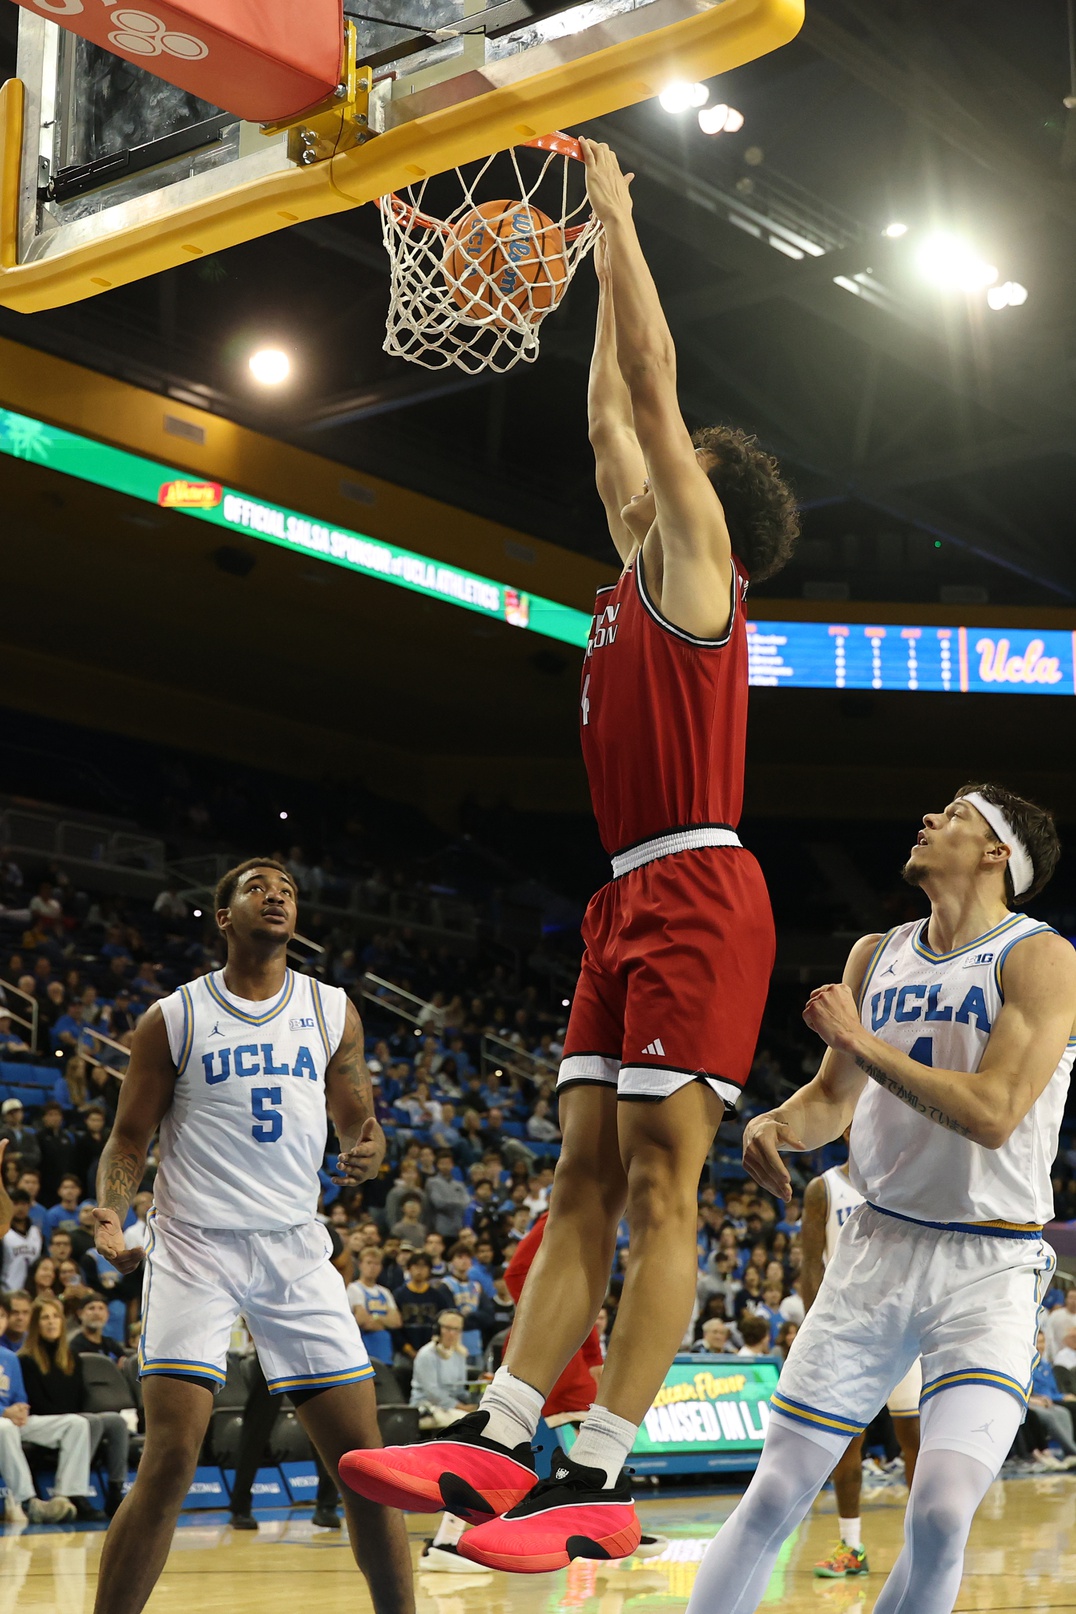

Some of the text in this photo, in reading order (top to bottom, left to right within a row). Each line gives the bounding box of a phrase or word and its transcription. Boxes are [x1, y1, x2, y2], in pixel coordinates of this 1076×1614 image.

[223, 494, 286, 539] OFFICIAL
[287, 516, 331, 554] SALSA
[330, 531, 392, 575] SPONSOR
[402, 556, 436, 590] UCLA
[436, 568, 500, 611] ATHLETICS
[976, 638, 1063, 684] Ucla
[871, 983, 992, 1034] UCLA
[202, 1043, 318, 1086] UCLA
[251, 1086, 283, 1143] 5
[643, 1401, 721, 1442] RAISED
[715, 1401, 746, 1440] IN
